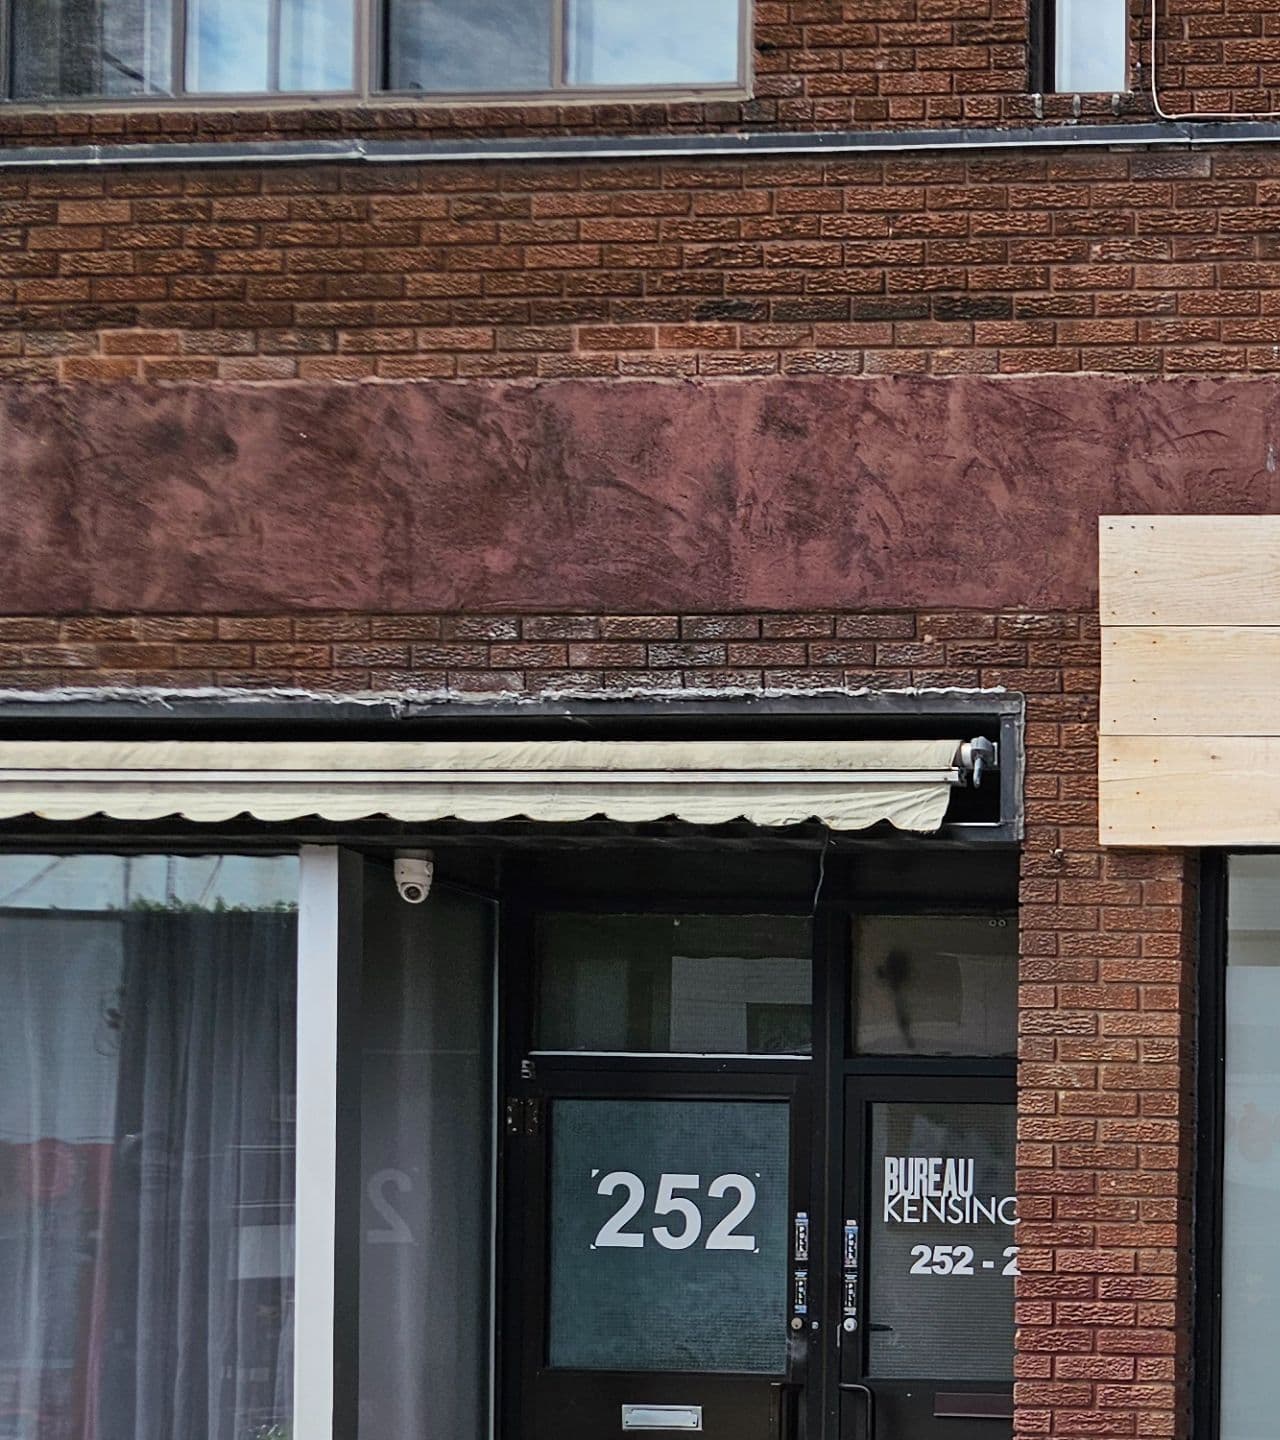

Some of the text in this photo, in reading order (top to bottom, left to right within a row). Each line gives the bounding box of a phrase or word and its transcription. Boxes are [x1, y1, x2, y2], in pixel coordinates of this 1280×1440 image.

[885, 1156, 974, 1199] BUREAU
[595, 1171, 757, 1250] 252
[910, 1244, 974, 1275] 252
